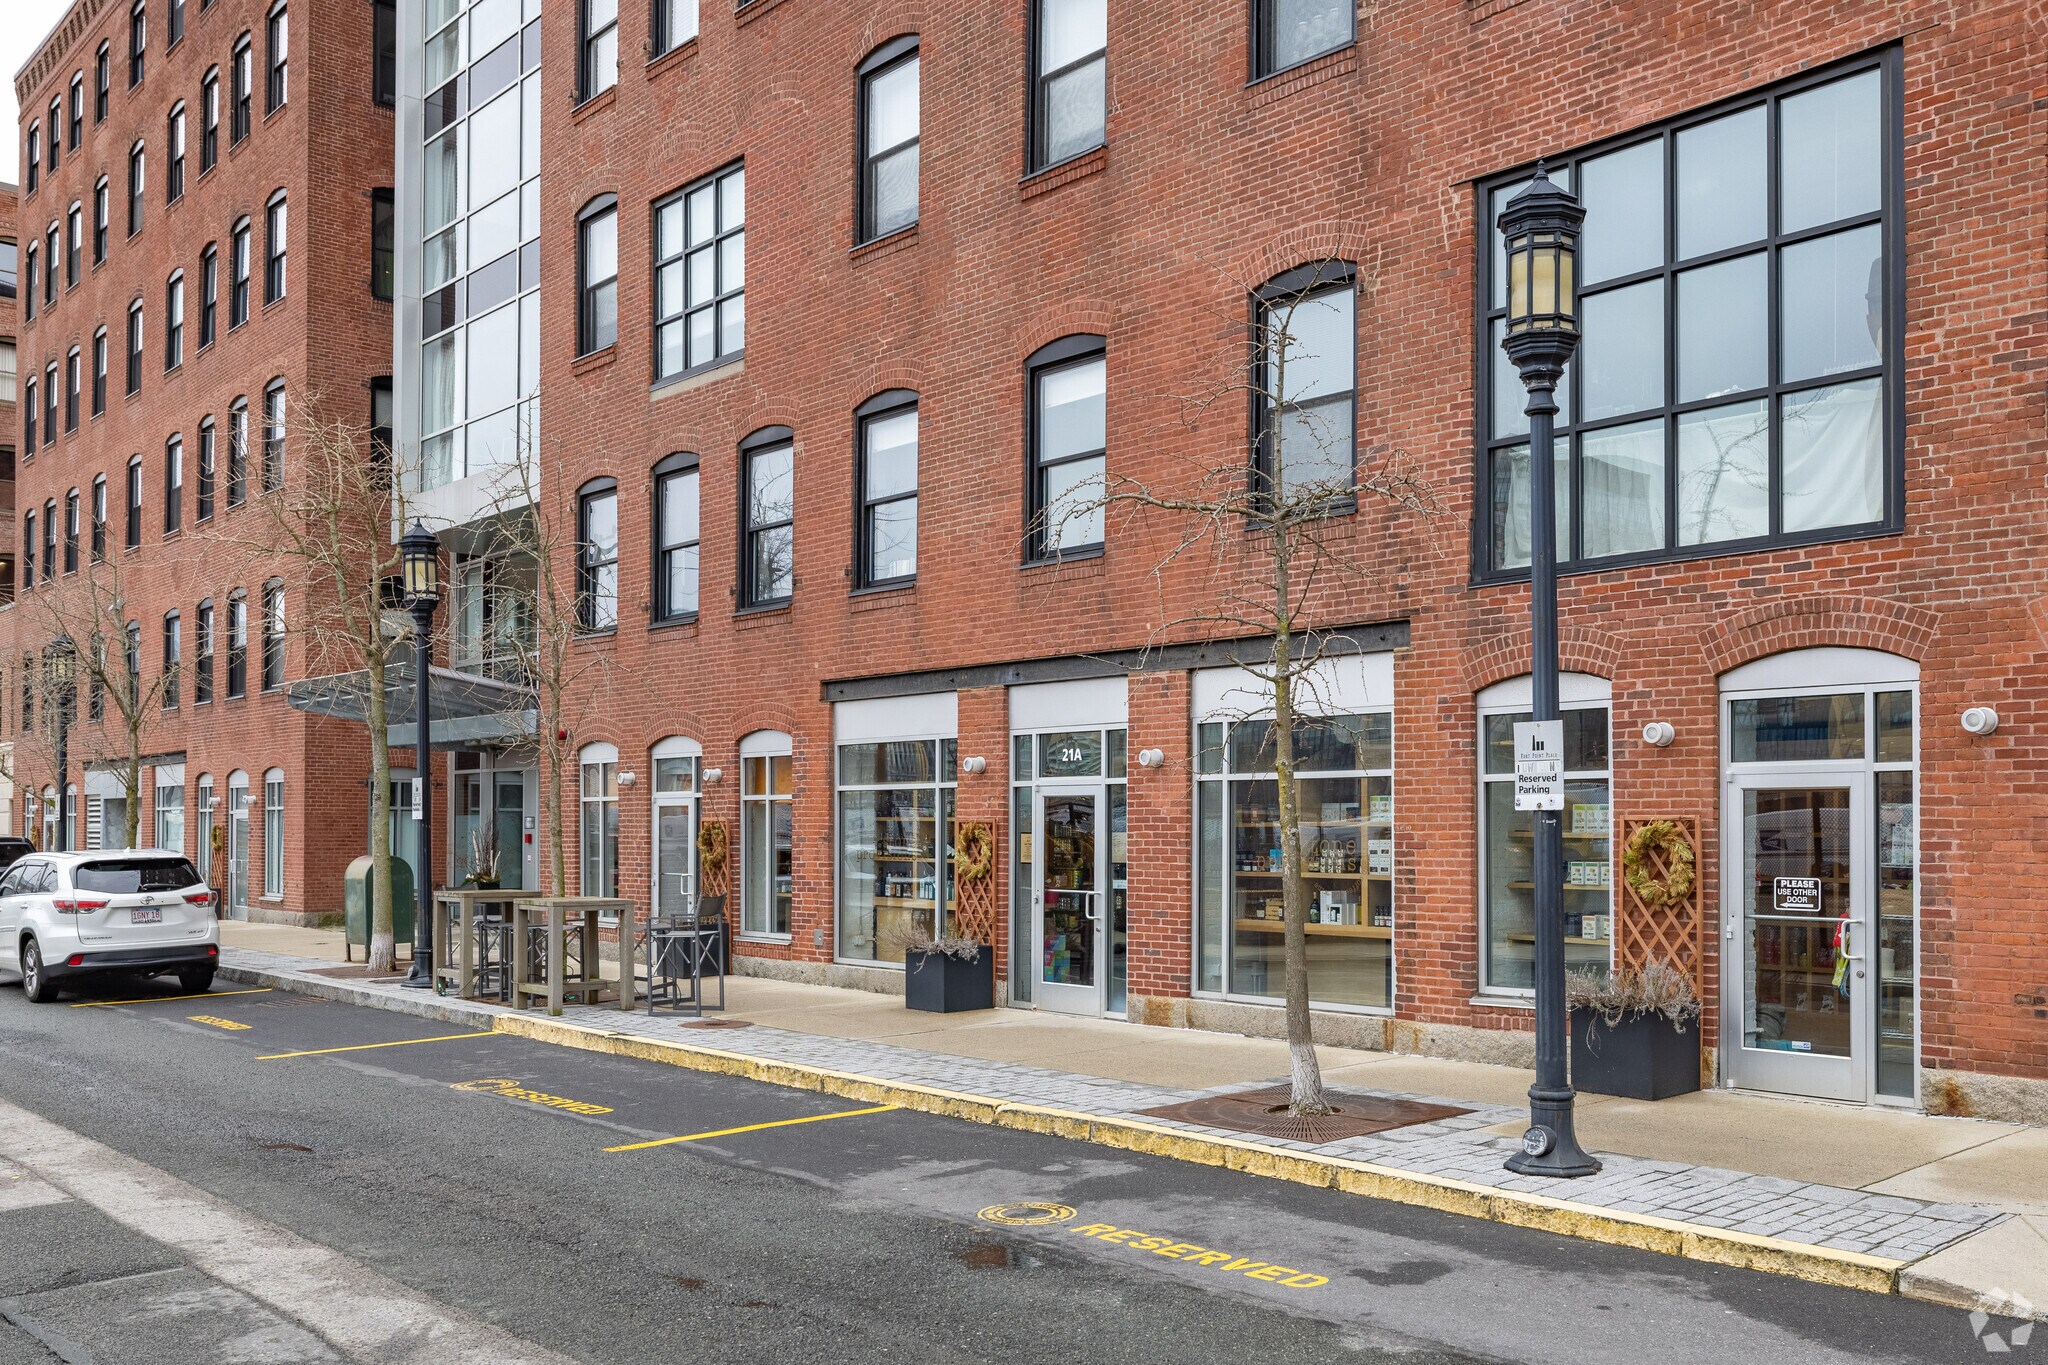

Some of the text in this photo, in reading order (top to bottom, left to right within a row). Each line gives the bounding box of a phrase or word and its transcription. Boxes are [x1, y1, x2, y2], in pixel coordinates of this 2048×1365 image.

[1062, 748, 1082, 761] 21A
[1518, 773, 1557, 783] Reserved
[1518, 785, 1550, 794] Parking
[1781, 880, 1814, 888] PLEASE
[1071, 1223, 1330, 1288] RESERVED
